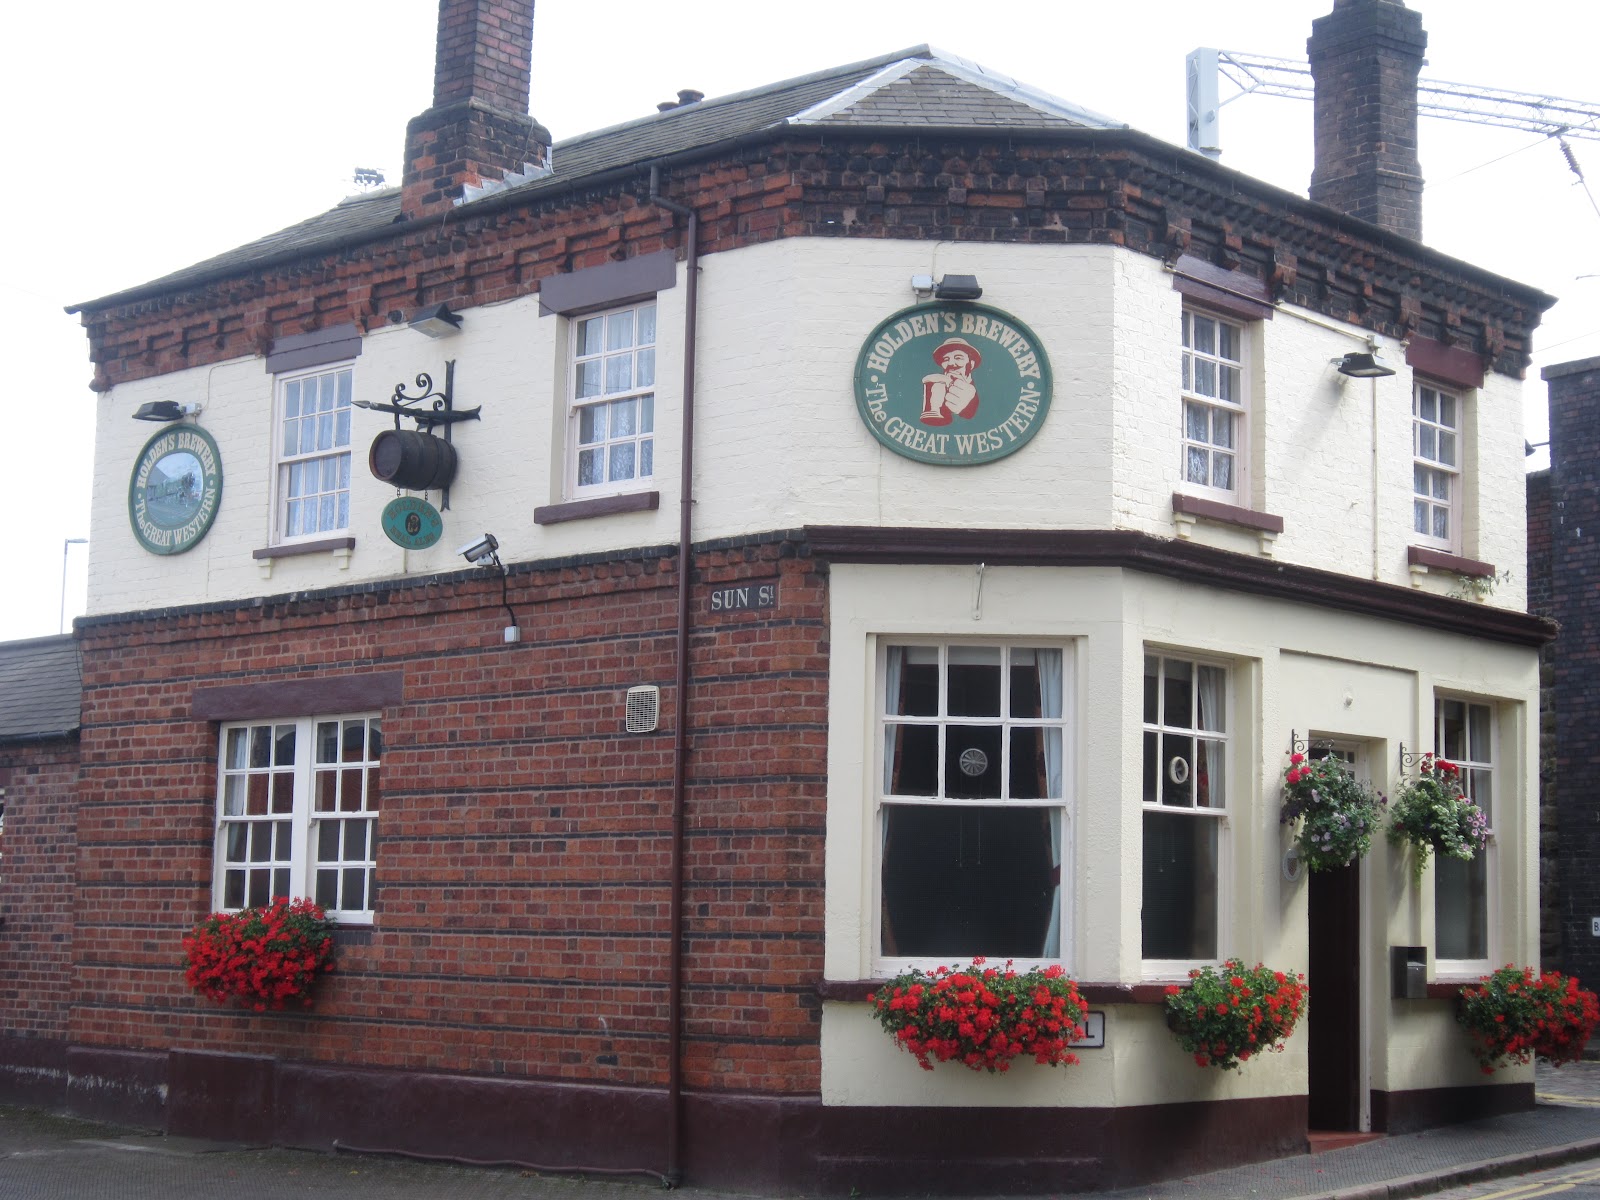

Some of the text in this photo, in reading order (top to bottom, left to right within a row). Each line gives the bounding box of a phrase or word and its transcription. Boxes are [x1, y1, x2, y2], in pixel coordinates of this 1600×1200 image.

[867, 311, 1041, 379] HOLDEN'S BREWERY
[865, 383, 1041, 455] The GREAT WESTERN
[137, 433, 216, 488] HOLDEN'S BREWERY
[135, 487, 216, 546] The GREAT WESTERN
[711, 587, 749, 610] SUN
